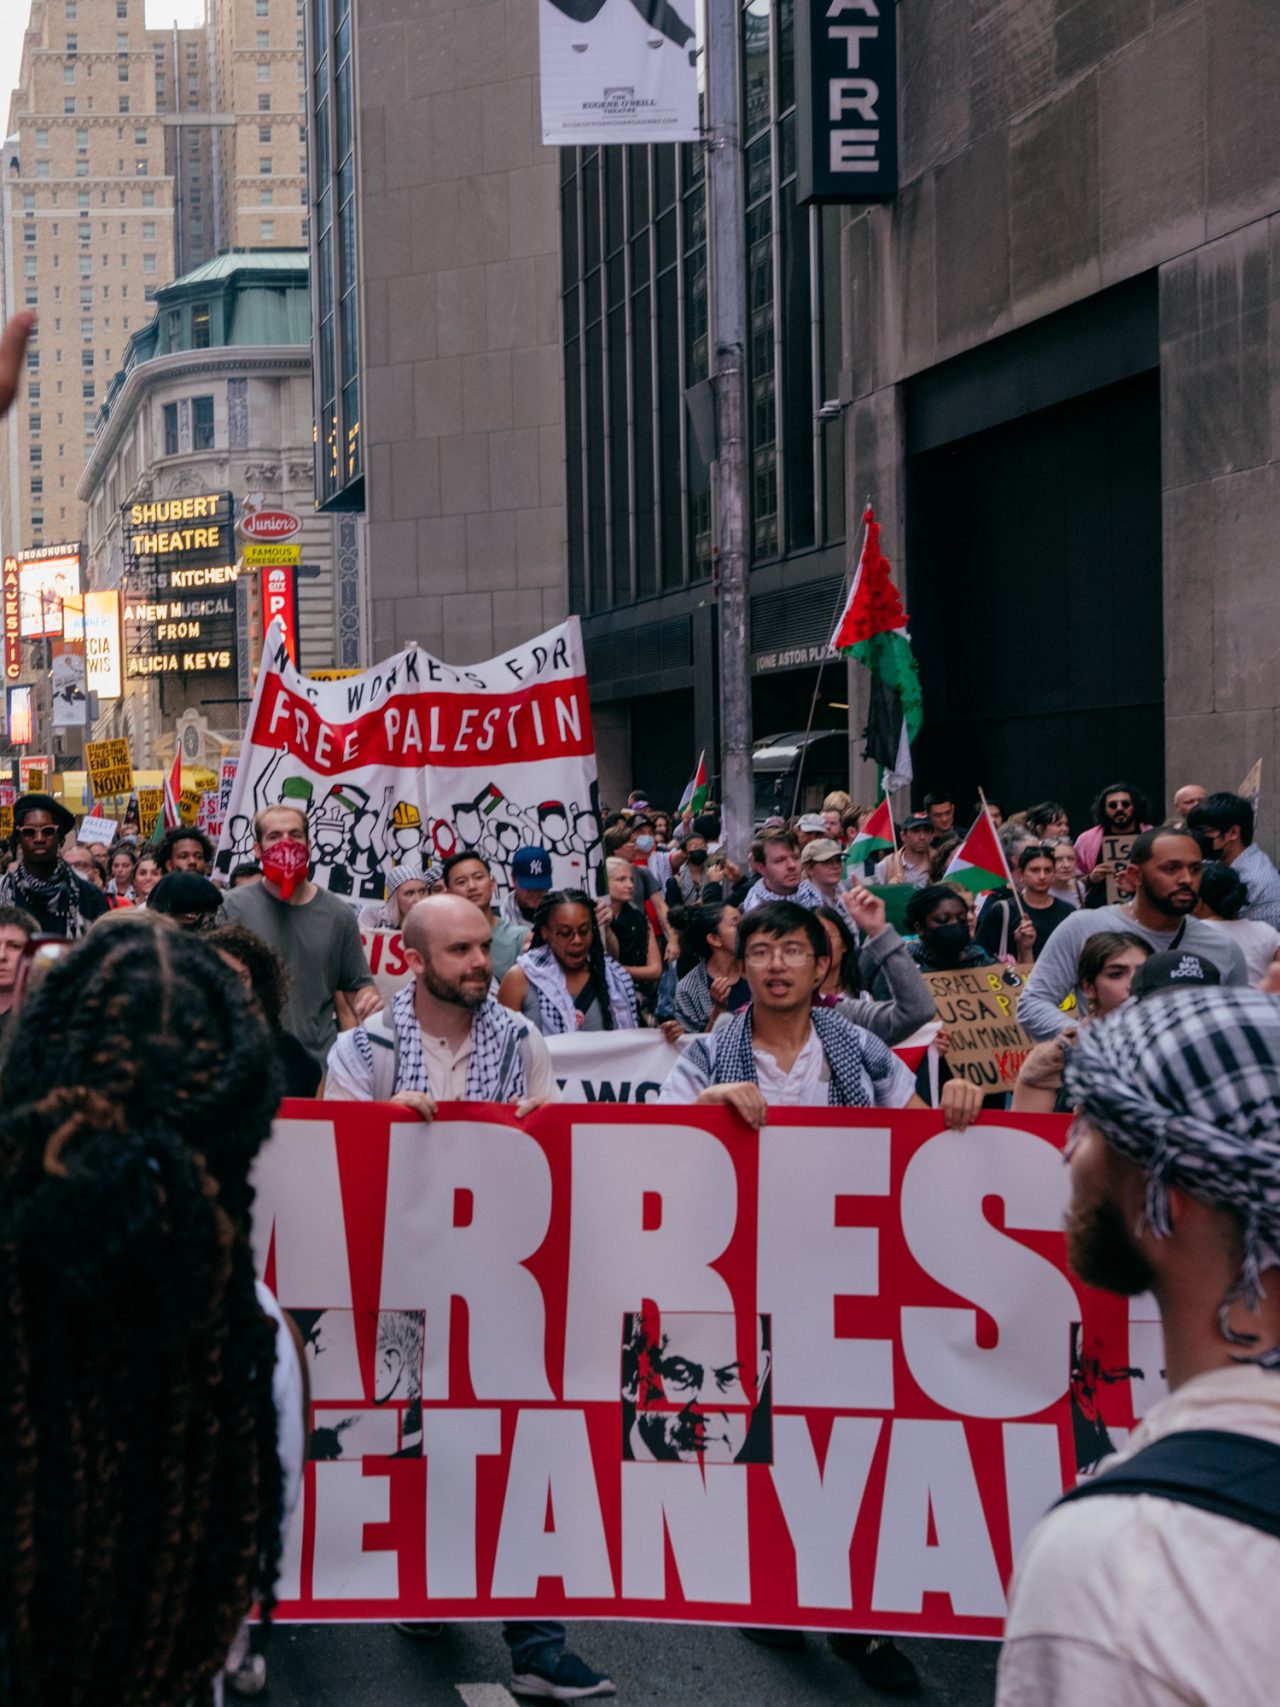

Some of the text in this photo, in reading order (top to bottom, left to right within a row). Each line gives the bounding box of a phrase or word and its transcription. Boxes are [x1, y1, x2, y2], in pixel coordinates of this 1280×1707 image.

[582, 99, 657, 109] EUGENE O'NEILL
[131, 495, 219, 525] SHUBERT
[247, 513, 298, 533] Junior's
[131, 526, 219, 555] THEATRE
[18, 543, 80, 561] BROADHURST
[246, 555, 298, 565] CHEESECAKE
[252, 547, 292, 557] FAMOUS
[171, 564, 239, 587] KITCHEN
[4, 558, 20, 679] MAJESTIC
[124, 598, 234, 621] A NEW MUSICAL
[157, 622, 200, 641] FROM
[128, 651, 231, 673] ALICIA KEYS
[505, 637, 571, 680] FOR
[778, 650, 807, 667] ASTOR
[269, 690, 583, 767] FREE PALESTIN
[90, 756, 129, 770] END THE
[93, 774, 132, 794] NOW!
[1170, 968, 1204, 979] BOOKS
[936, 998, 997, 1024] USA
[977, 1024, 1023, 1049] MANY
[952, 1060, 998, 1087] YOU
[250, 1120, 1168, 1420] ARRES
